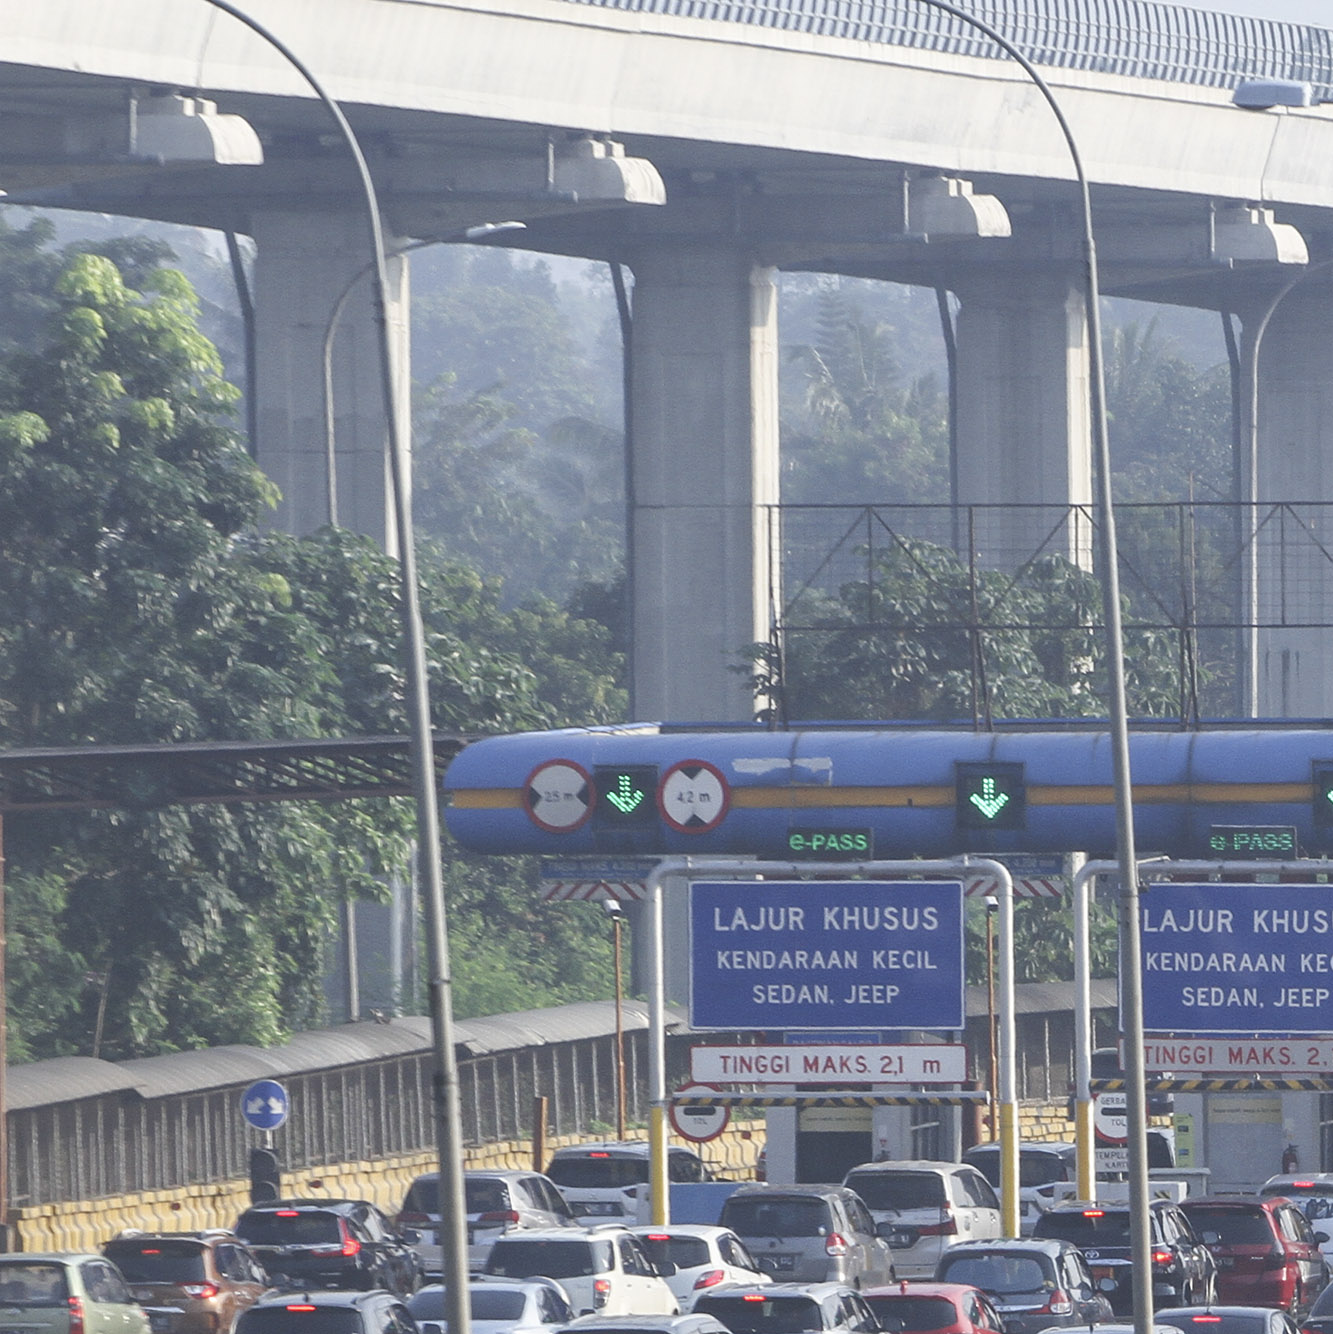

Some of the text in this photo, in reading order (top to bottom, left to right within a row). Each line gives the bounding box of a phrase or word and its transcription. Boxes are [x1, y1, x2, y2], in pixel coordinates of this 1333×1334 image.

[699, 792, 710, 802] m
[789, 834, 868, 852] e-PASS
[713, 906, 939, 931] LAJUR KHUSUS
[1143, 908, 1234, 933] LAJUR
[716, 950, 938, 970] KENDARAAN KECIL
[1146, 952, 1286, 973] KENDARAAN
[844, 985, 900, 1004] JEEP
[1273, 988, 1331, 1008] JEEP
[719, 1055, 941, 1076] TINGGI MAKS. 2,1 m
[1144, 1046, 1213, 1065] TINGGI
[1228, 1046, 1296, 1066] MAKS.
